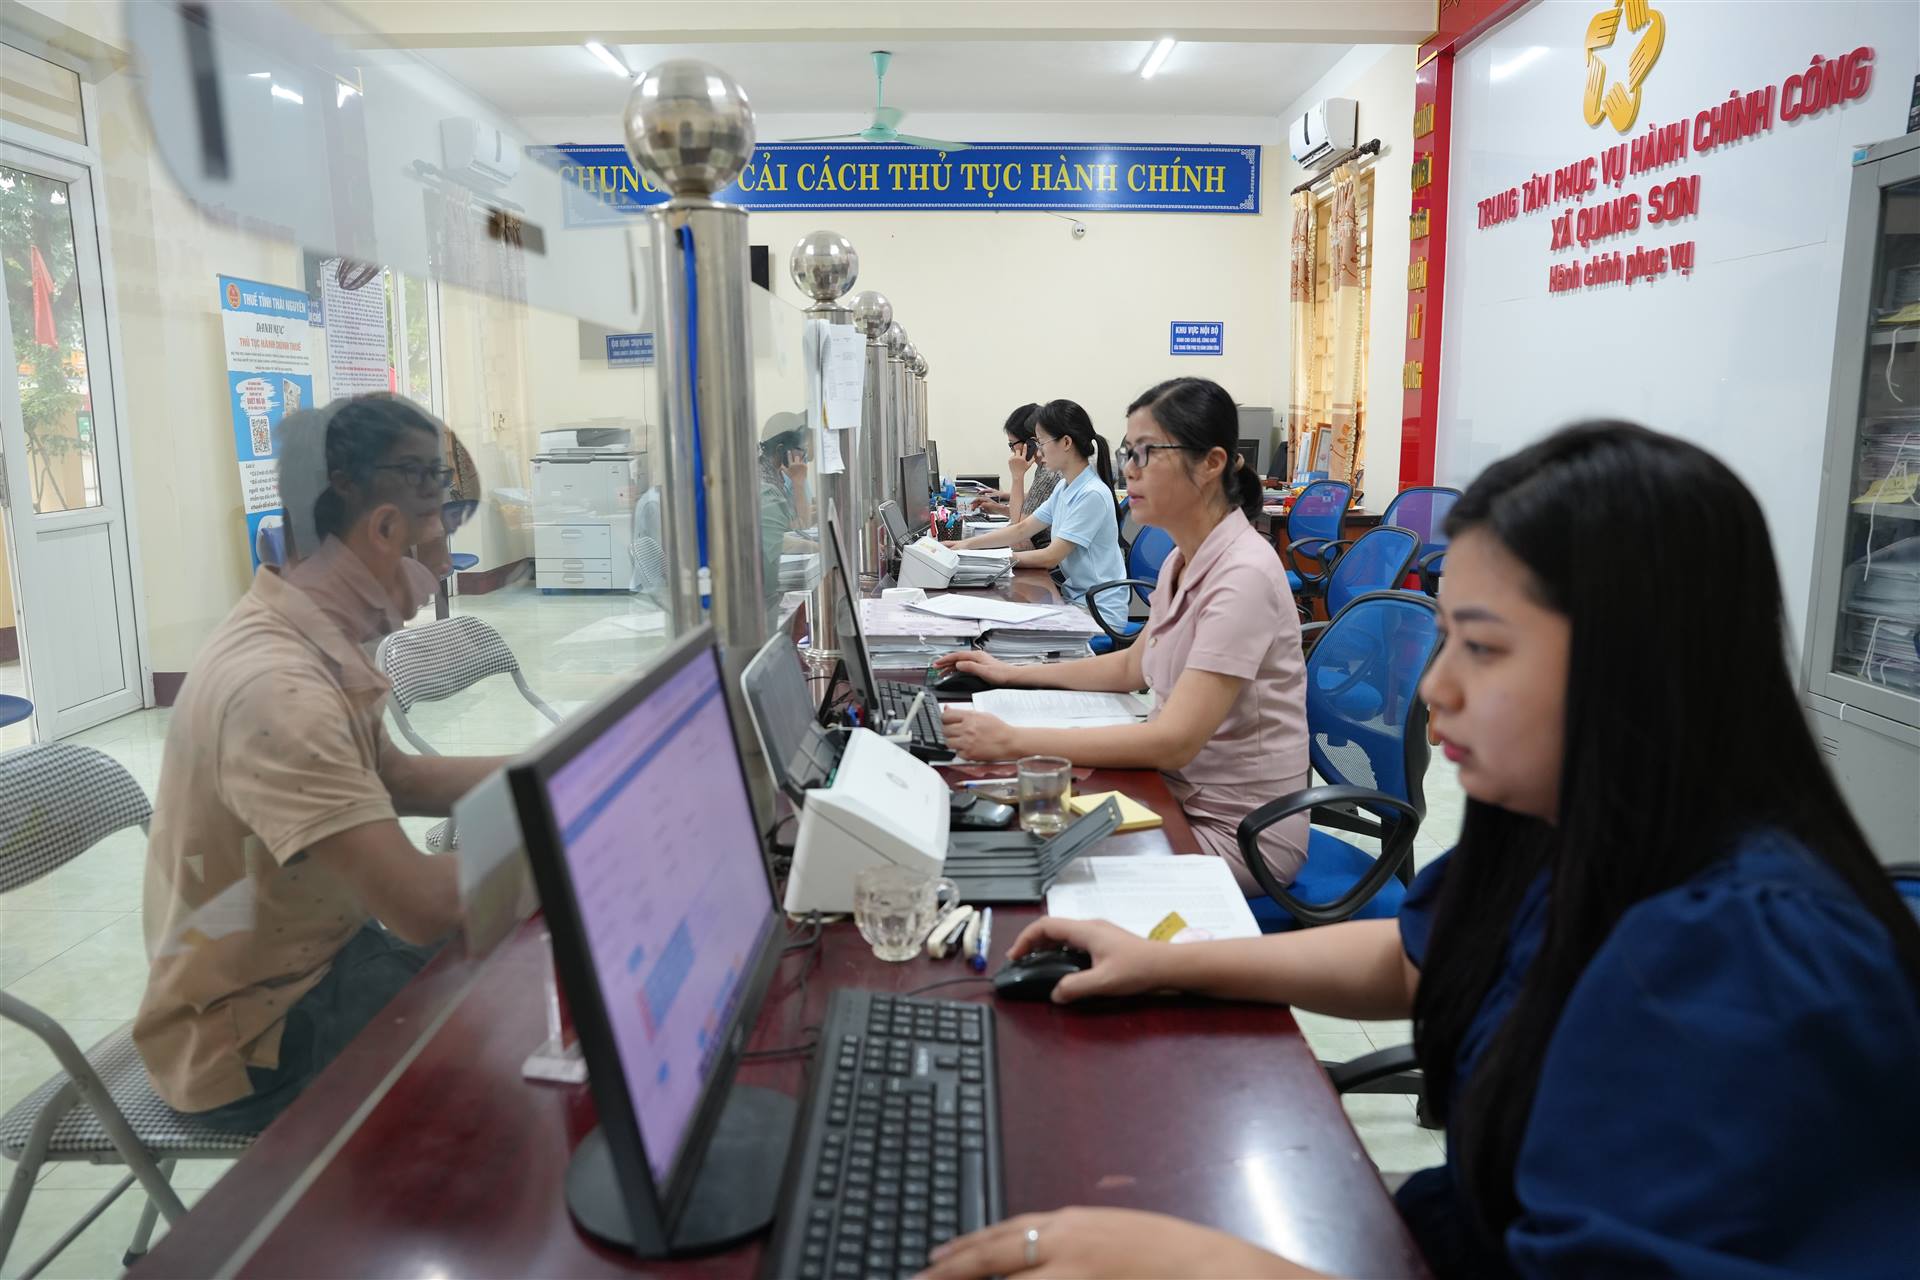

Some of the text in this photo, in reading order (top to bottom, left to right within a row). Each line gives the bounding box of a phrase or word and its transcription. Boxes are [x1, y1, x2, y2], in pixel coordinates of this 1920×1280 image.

[1478, 47, 1875, 229] TRUNG TÂM PHỤC VỤ HÀNH CHÍNH CÔNG
[738, 153, 788, 191] CẢI
[797, 155, 879, 191] CÁCH
[888, 151, 952, 191] THỦ
[960, 164, 1022, 198] TỤC
[1030, 154, 1118, 191] HÀNH
[1127, 156, 1226, 193] CHÍNH
[1551, 175, 1700, 251] XÃ QUANG SƠN
[1549, 260, 1582, 292] Hành
[1584, 251, 1624, 286] chính
[1625, 246, 1667, 285] phục
[1176, 326, 1187, 334] KHU
